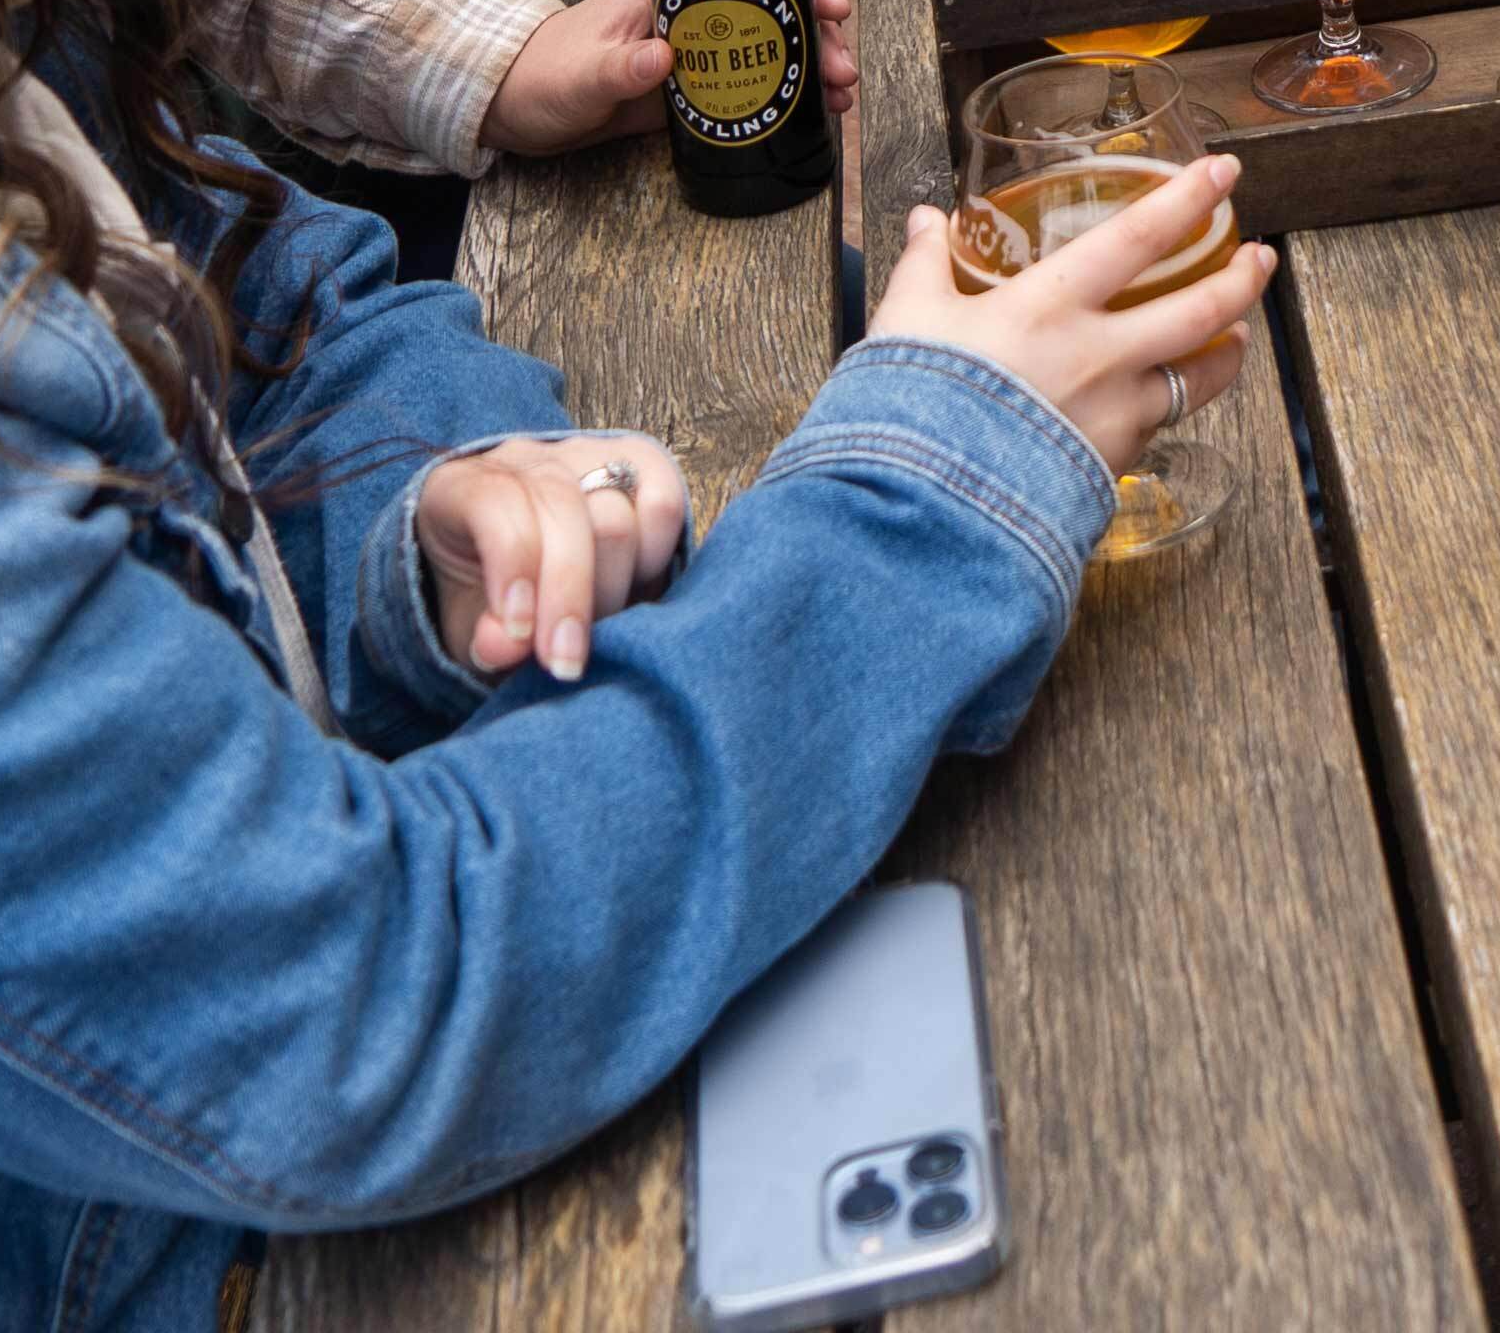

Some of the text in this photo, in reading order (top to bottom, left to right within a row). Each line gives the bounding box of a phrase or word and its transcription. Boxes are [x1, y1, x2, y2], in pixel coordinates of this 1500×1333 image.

[739, 25, 761, 37] 1891
[674, 39, 780, 73] ROOT BEER
[690, 74, 768, 90] CANE SUGAR
